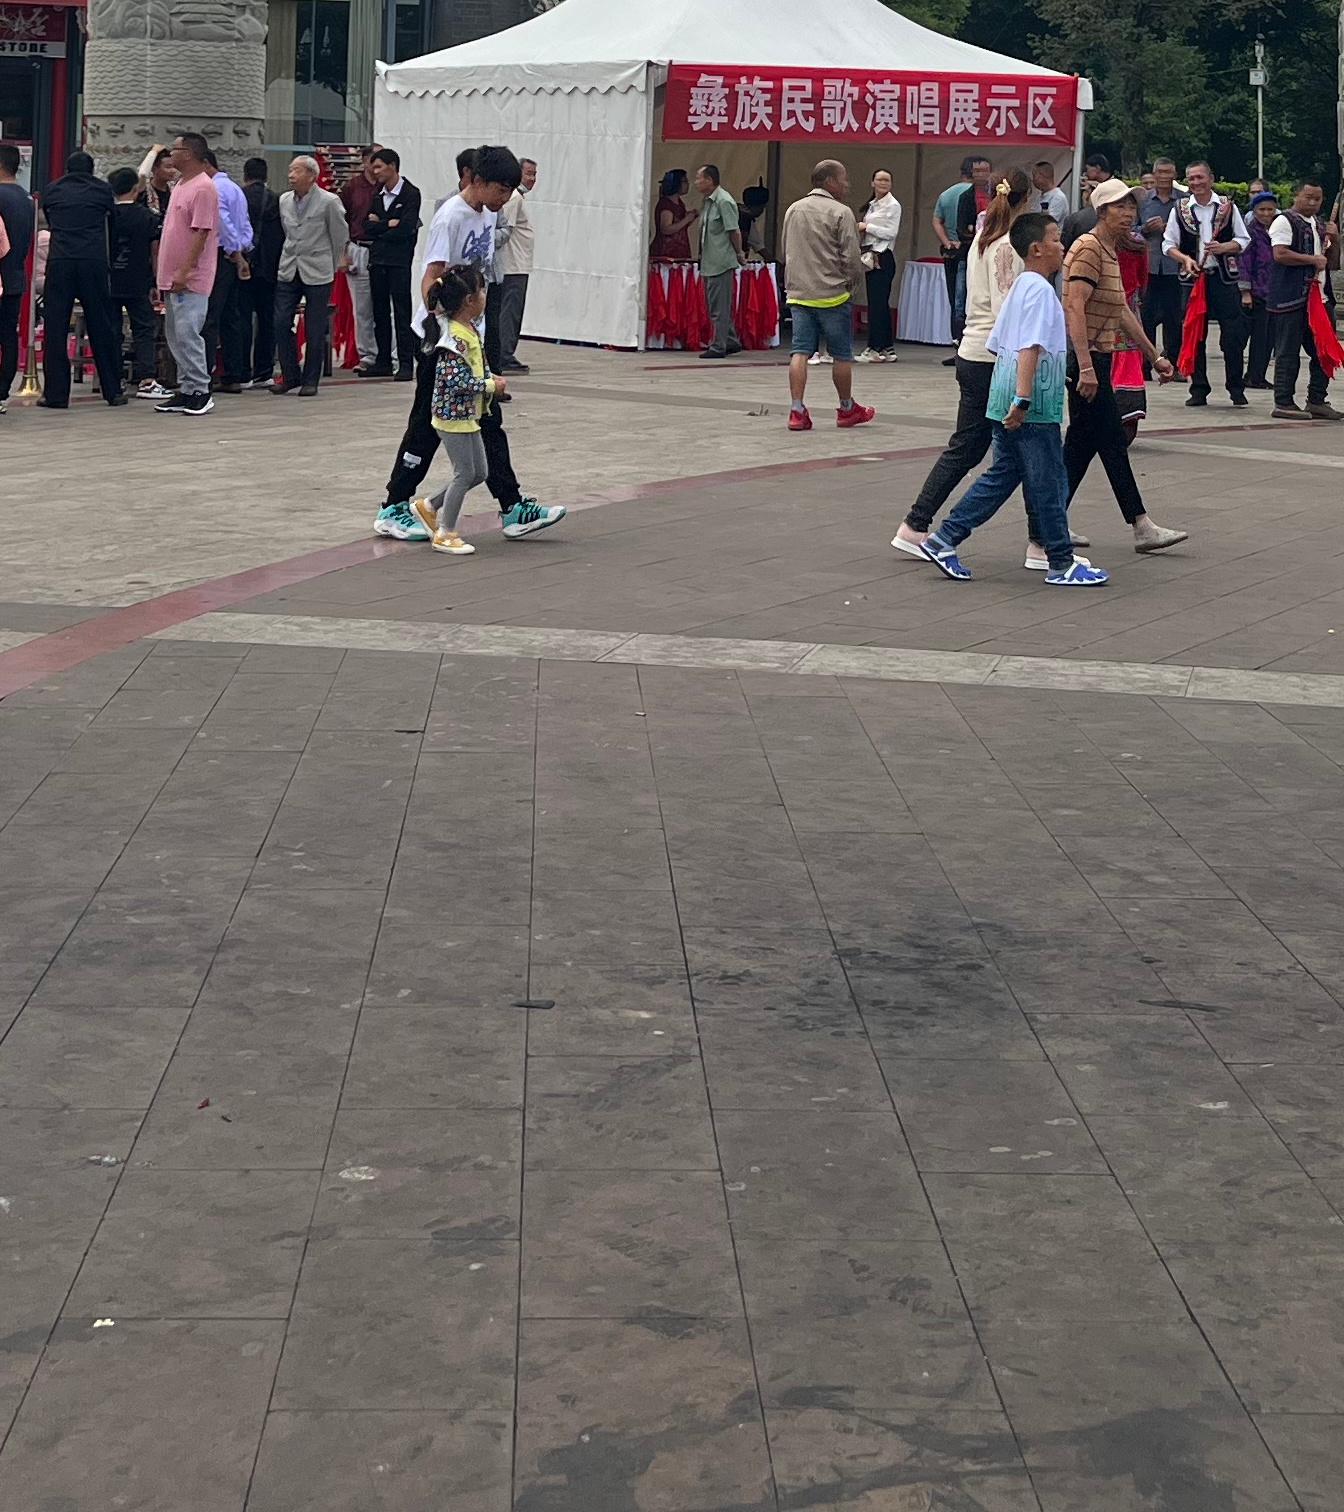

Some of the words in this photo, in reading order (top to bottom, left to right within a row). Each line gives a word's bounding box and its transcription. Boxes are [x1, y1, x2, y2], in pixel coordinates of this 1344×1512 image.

[687, 73, 1058, 137] 彝族民歌演唱展示区
